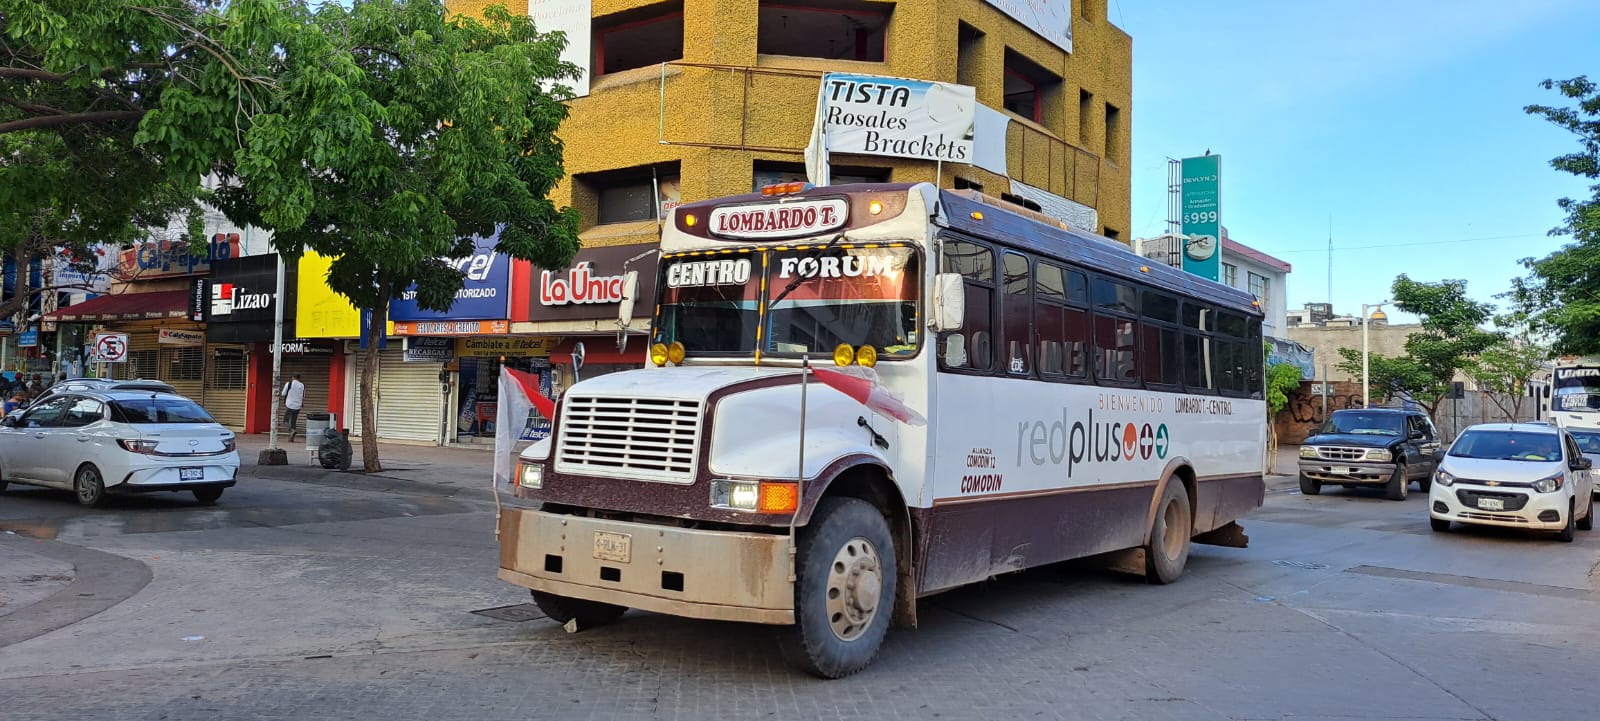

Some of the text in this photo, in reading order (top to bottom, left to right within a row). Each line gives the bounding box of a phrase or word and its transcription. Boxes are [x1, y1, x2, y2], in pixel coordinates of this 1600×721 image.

[825, 80, 911, 108] TISTA
[828, 105, 908, 131] Rosales
[864, 130, 967, 160] Brackets
[718, 206, 837, 233] LOMBARDO T.
[1183, 210, 1217, 224] $999
[667, 259, 752, 288] CENTRO
[779, 255, 894, 279] FORUM
[455, 288, 496, 299] TORIZADO
[541, 261, 625, 305] La Únic
[231, 287, 270, 310] Lizao
[1099, 394, 1163, 413] BIENVENIDO
[972, 447, 992, 455] ALIANZA
[1016, 406, 1121, 478] redplus
[966, 455, 996, 469] COMODIN 12
[960, 473, 1003, 494] COMODIN
